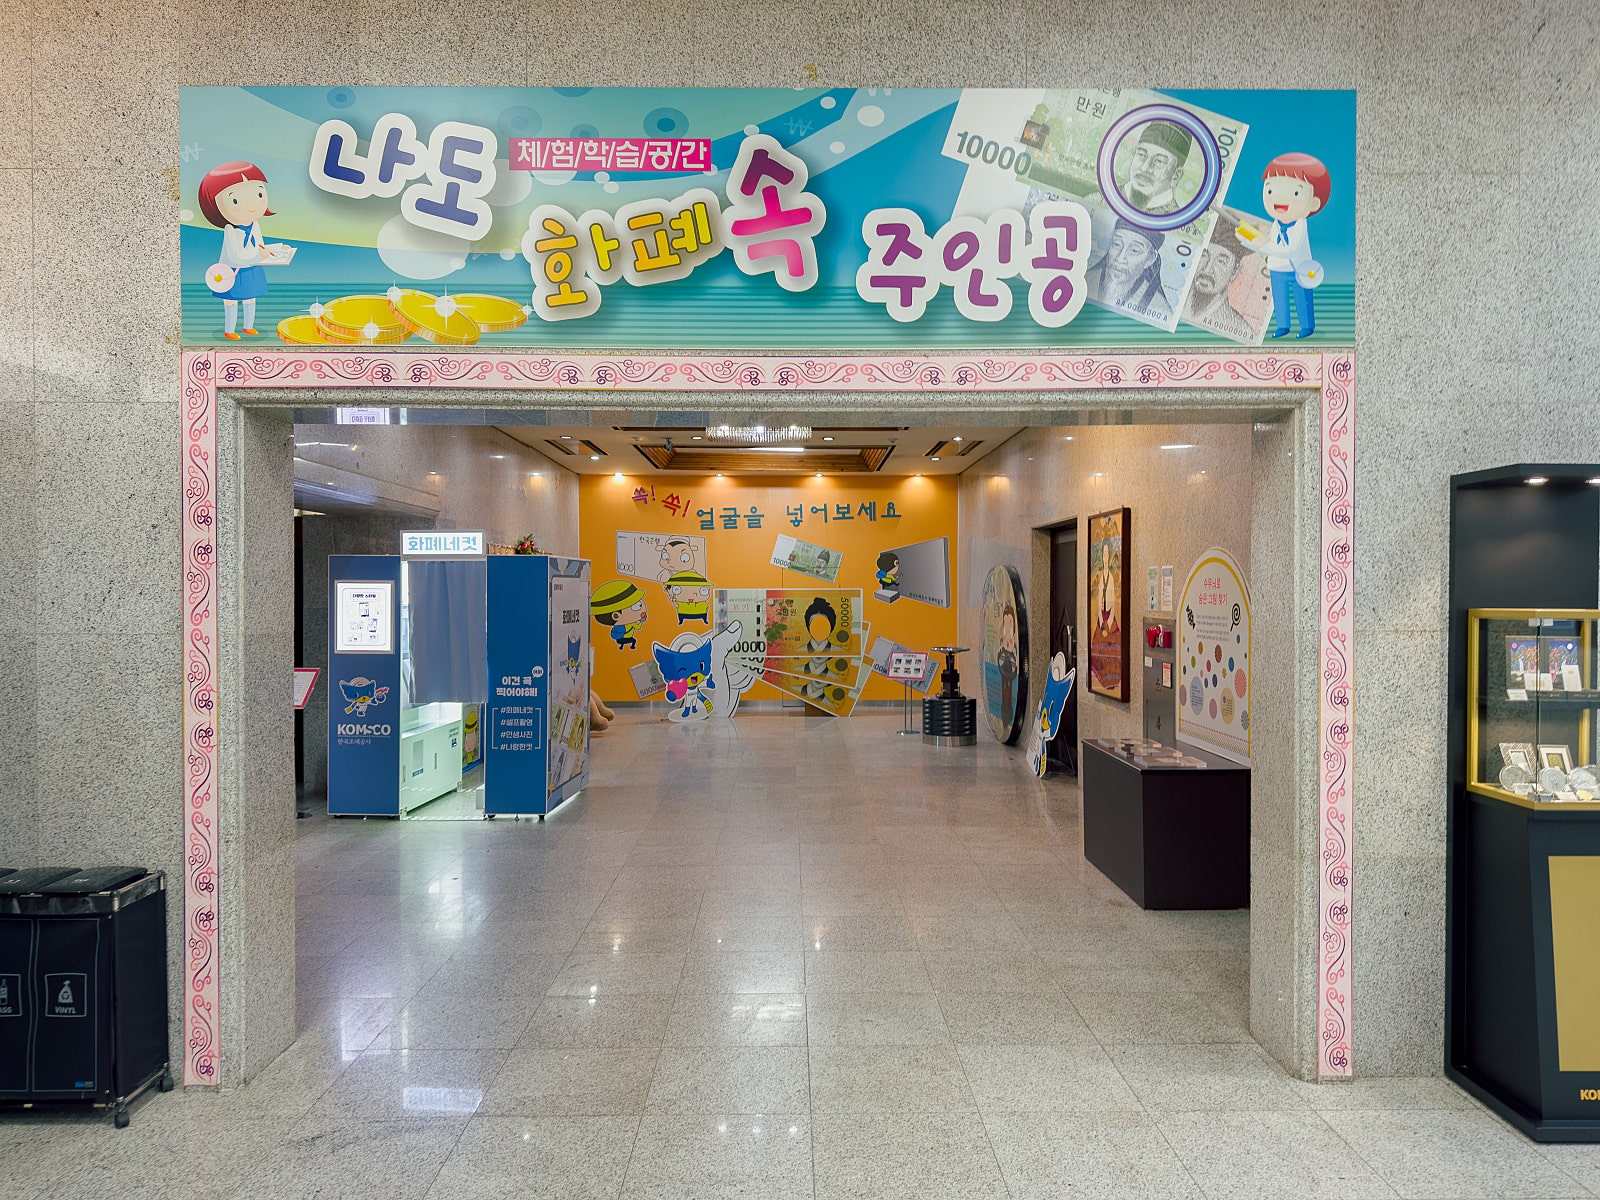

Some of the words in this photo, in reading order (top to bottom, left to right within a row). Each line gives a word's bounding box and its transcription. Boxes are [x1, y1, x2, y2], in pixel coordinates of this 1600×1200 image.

[956, 130, 1032, 176] 10000
[323, 127, 484, 227] 나도
[535, 202, 713, 310] 화폐
[731, 149, 813, 278] 속
[869, 215, 1079, 314] 주인공
[632, 485, 656, 504] 쏙!
[661, 492, 691, 518] 쏙!
[696, 505, 765, 530] 얼굴을
[786, 501, 902, 527] 넣어보세요
[408, 536, 477, 551] 화폐네컷
[502, 676, 520, 686] 이건
[523, 676, 532, 686] 꼭
[640, 686, 657, 697] 5000
[54, 1006, 77, 1014] VINYL
[1580, 1089, 1600, 1101] KO
